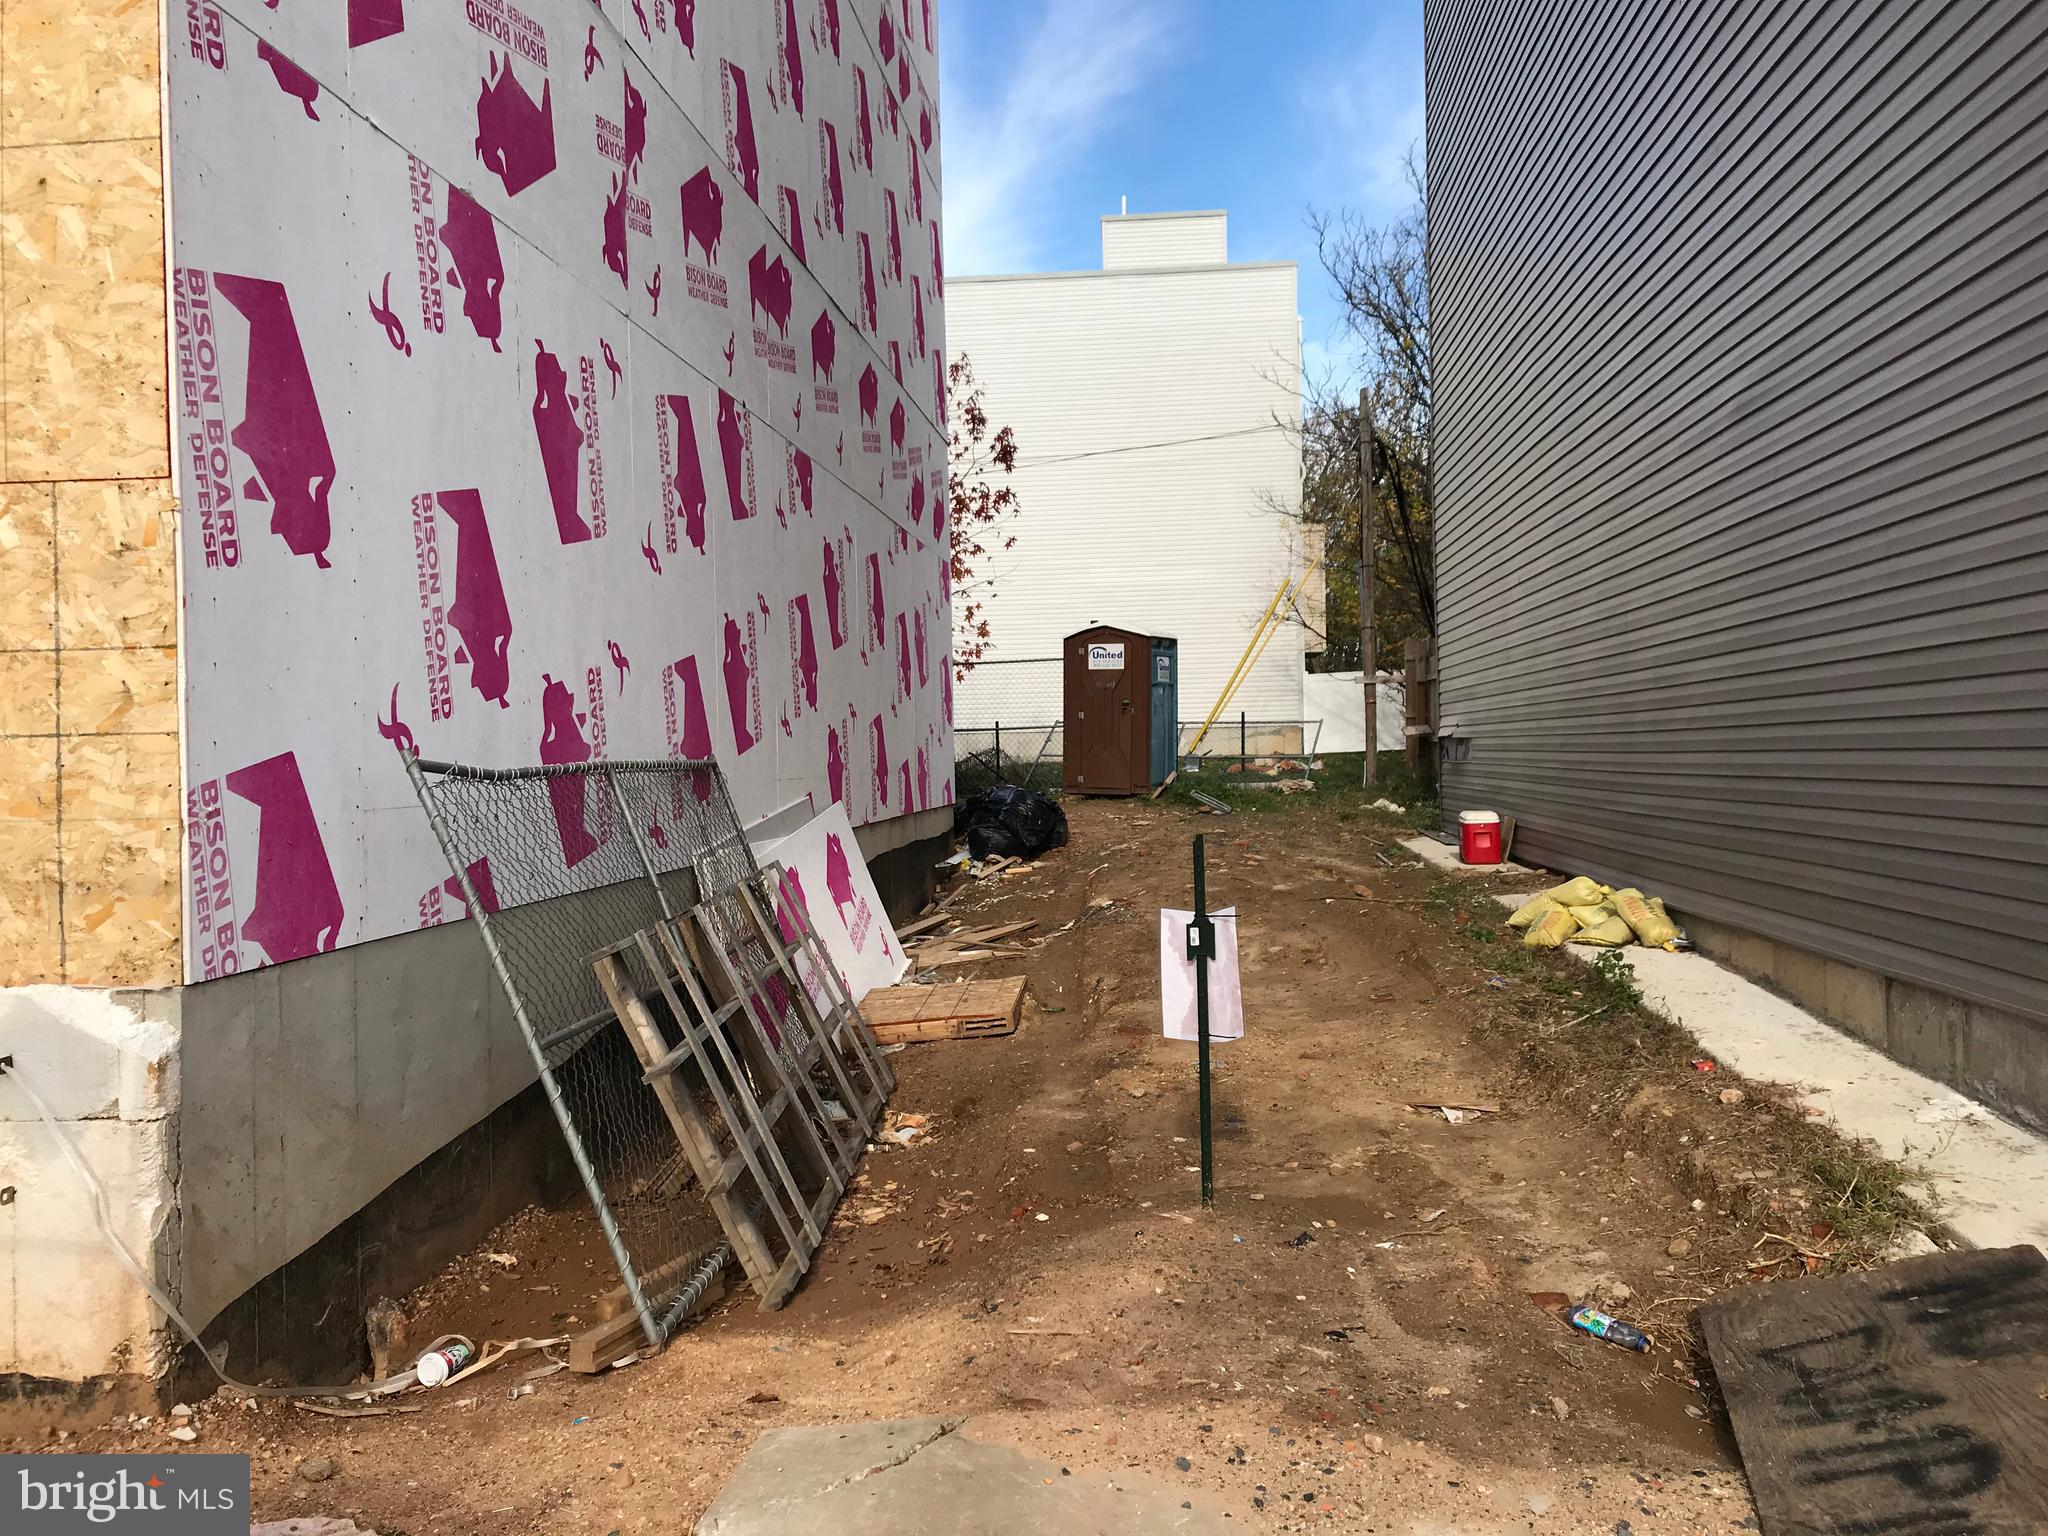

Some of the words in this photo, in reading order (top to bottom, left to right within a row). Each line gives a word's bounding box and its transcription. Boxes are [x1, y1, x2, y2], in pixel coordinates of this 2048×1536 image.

[466, 0, 510, 45] BOARD
[513, 28, 548, 68] BISON
[414, 223, 432, 331] DEFENSE
[424, 215, 444, 335] BOARD
[685, 265, 706, 287] BISON
[707, 273, 727, 295] BOARD
[173, 267, 200, 419] WEATHER
[190, 432, 219, 569] DEFENSE
[187, 267, 220, 404] BISON
[206, 418, 241, 569] BOARD
[580, 356, 594, 449] BOARD
[588, 358, 599, 440] DEFENSE
[587, 459, 602, 539] BISON
[595, 449, 607, 537] WEATHER
[660, 394, 670, 466] BISON
[666, 474, 677, 554] BOARD
[411, 495, 428, 609] WEATHER
[422, 619, 441, 722] DEFENSE
[420, 492, 441, 595] BISON
[432, 605, 453, 720] BOARD
[666, 665, 677, 735] BISON
[1092, 650, 1123, 660] United
[588, 667, 601, 758] BOARD
[595, 665, 607, 746] DEFENSE
[187, 788, 212, 936] WEATHER
[200, 779, 231, 912] BISON
